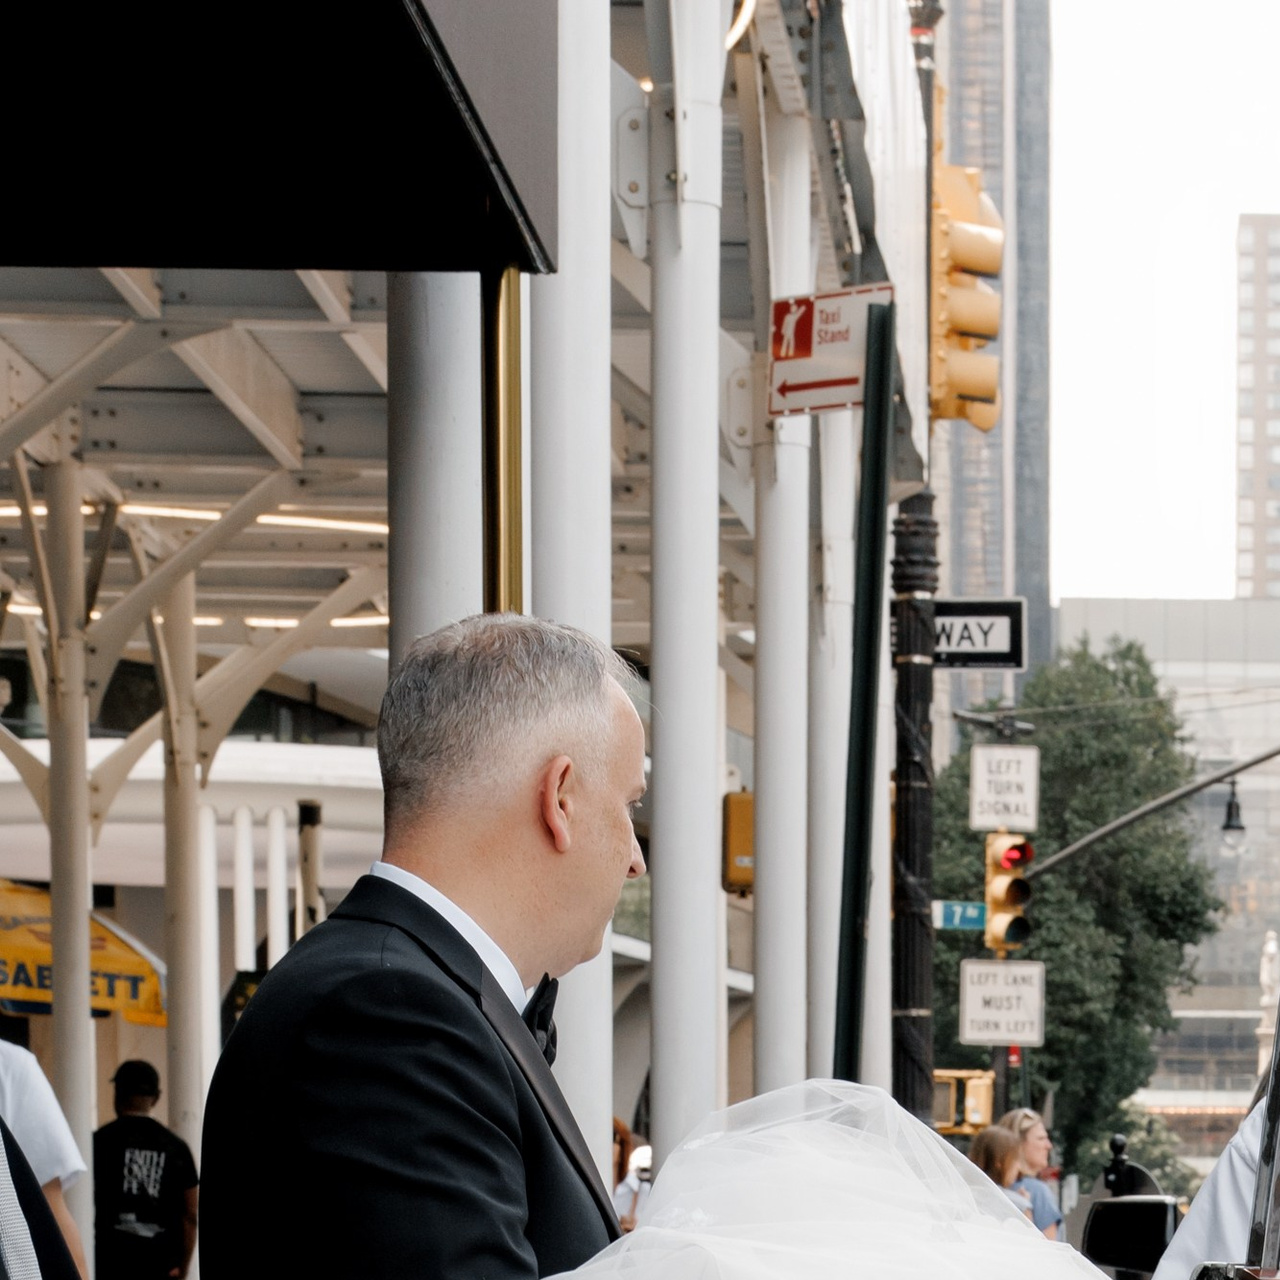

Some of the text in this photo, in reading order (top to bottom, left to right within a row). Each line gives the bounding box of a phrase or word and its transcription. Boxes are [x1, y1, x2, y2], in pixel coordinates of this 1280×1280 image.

[818, 306, 841, 324] Taxi
[816, 324, 850, 345] Stand
[935, 622, 995, 647] WAY
[987, 759, 1021, 774] LEFT
[987, 779, 1024, 795] TURN
[978, 800, 1029, 817] SIGNAL
[952, 905, 963, 927] 7
[0, 958, 144, 999] SABETT
[969, 972, 1034, 987] LEFT LANE
[982, 995, 1022, 1010] MUST
[969, 1019, 1035, 1033] TURN LEFT
[125, 1147, 166, 1167] FAITH
